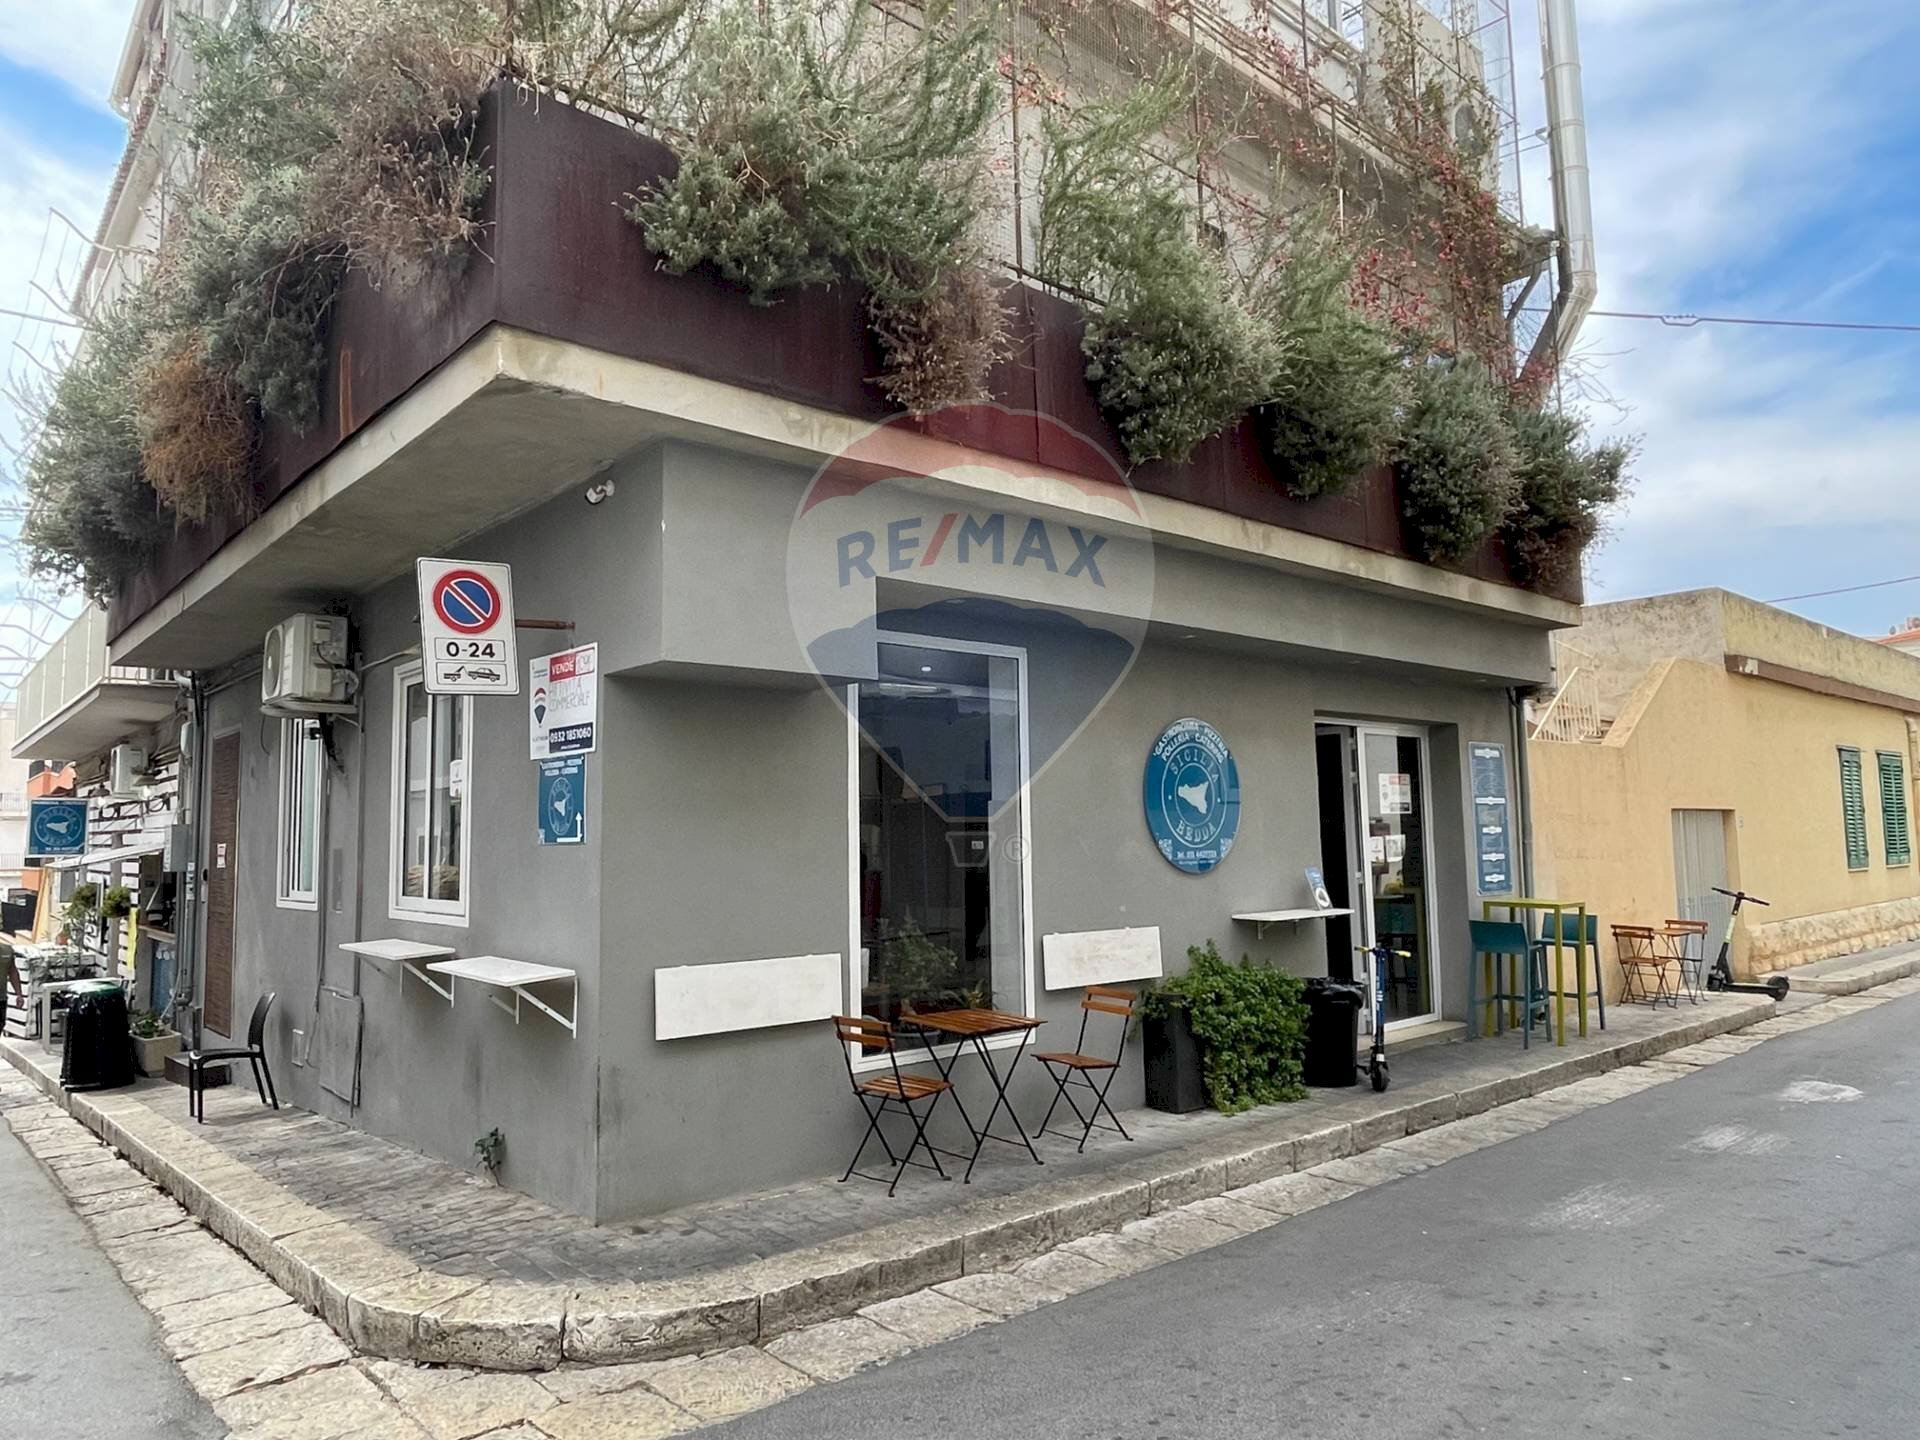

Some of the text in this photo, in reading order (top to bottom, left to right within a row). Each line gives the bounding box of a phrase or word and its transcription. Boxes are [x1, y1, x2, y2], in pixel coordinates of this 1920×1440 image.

[446, 641, 496, 659] 0-24
[1161, 732, 1190, 762] POLLERIA
[1170, 748, 1220, 784] SICILIA
